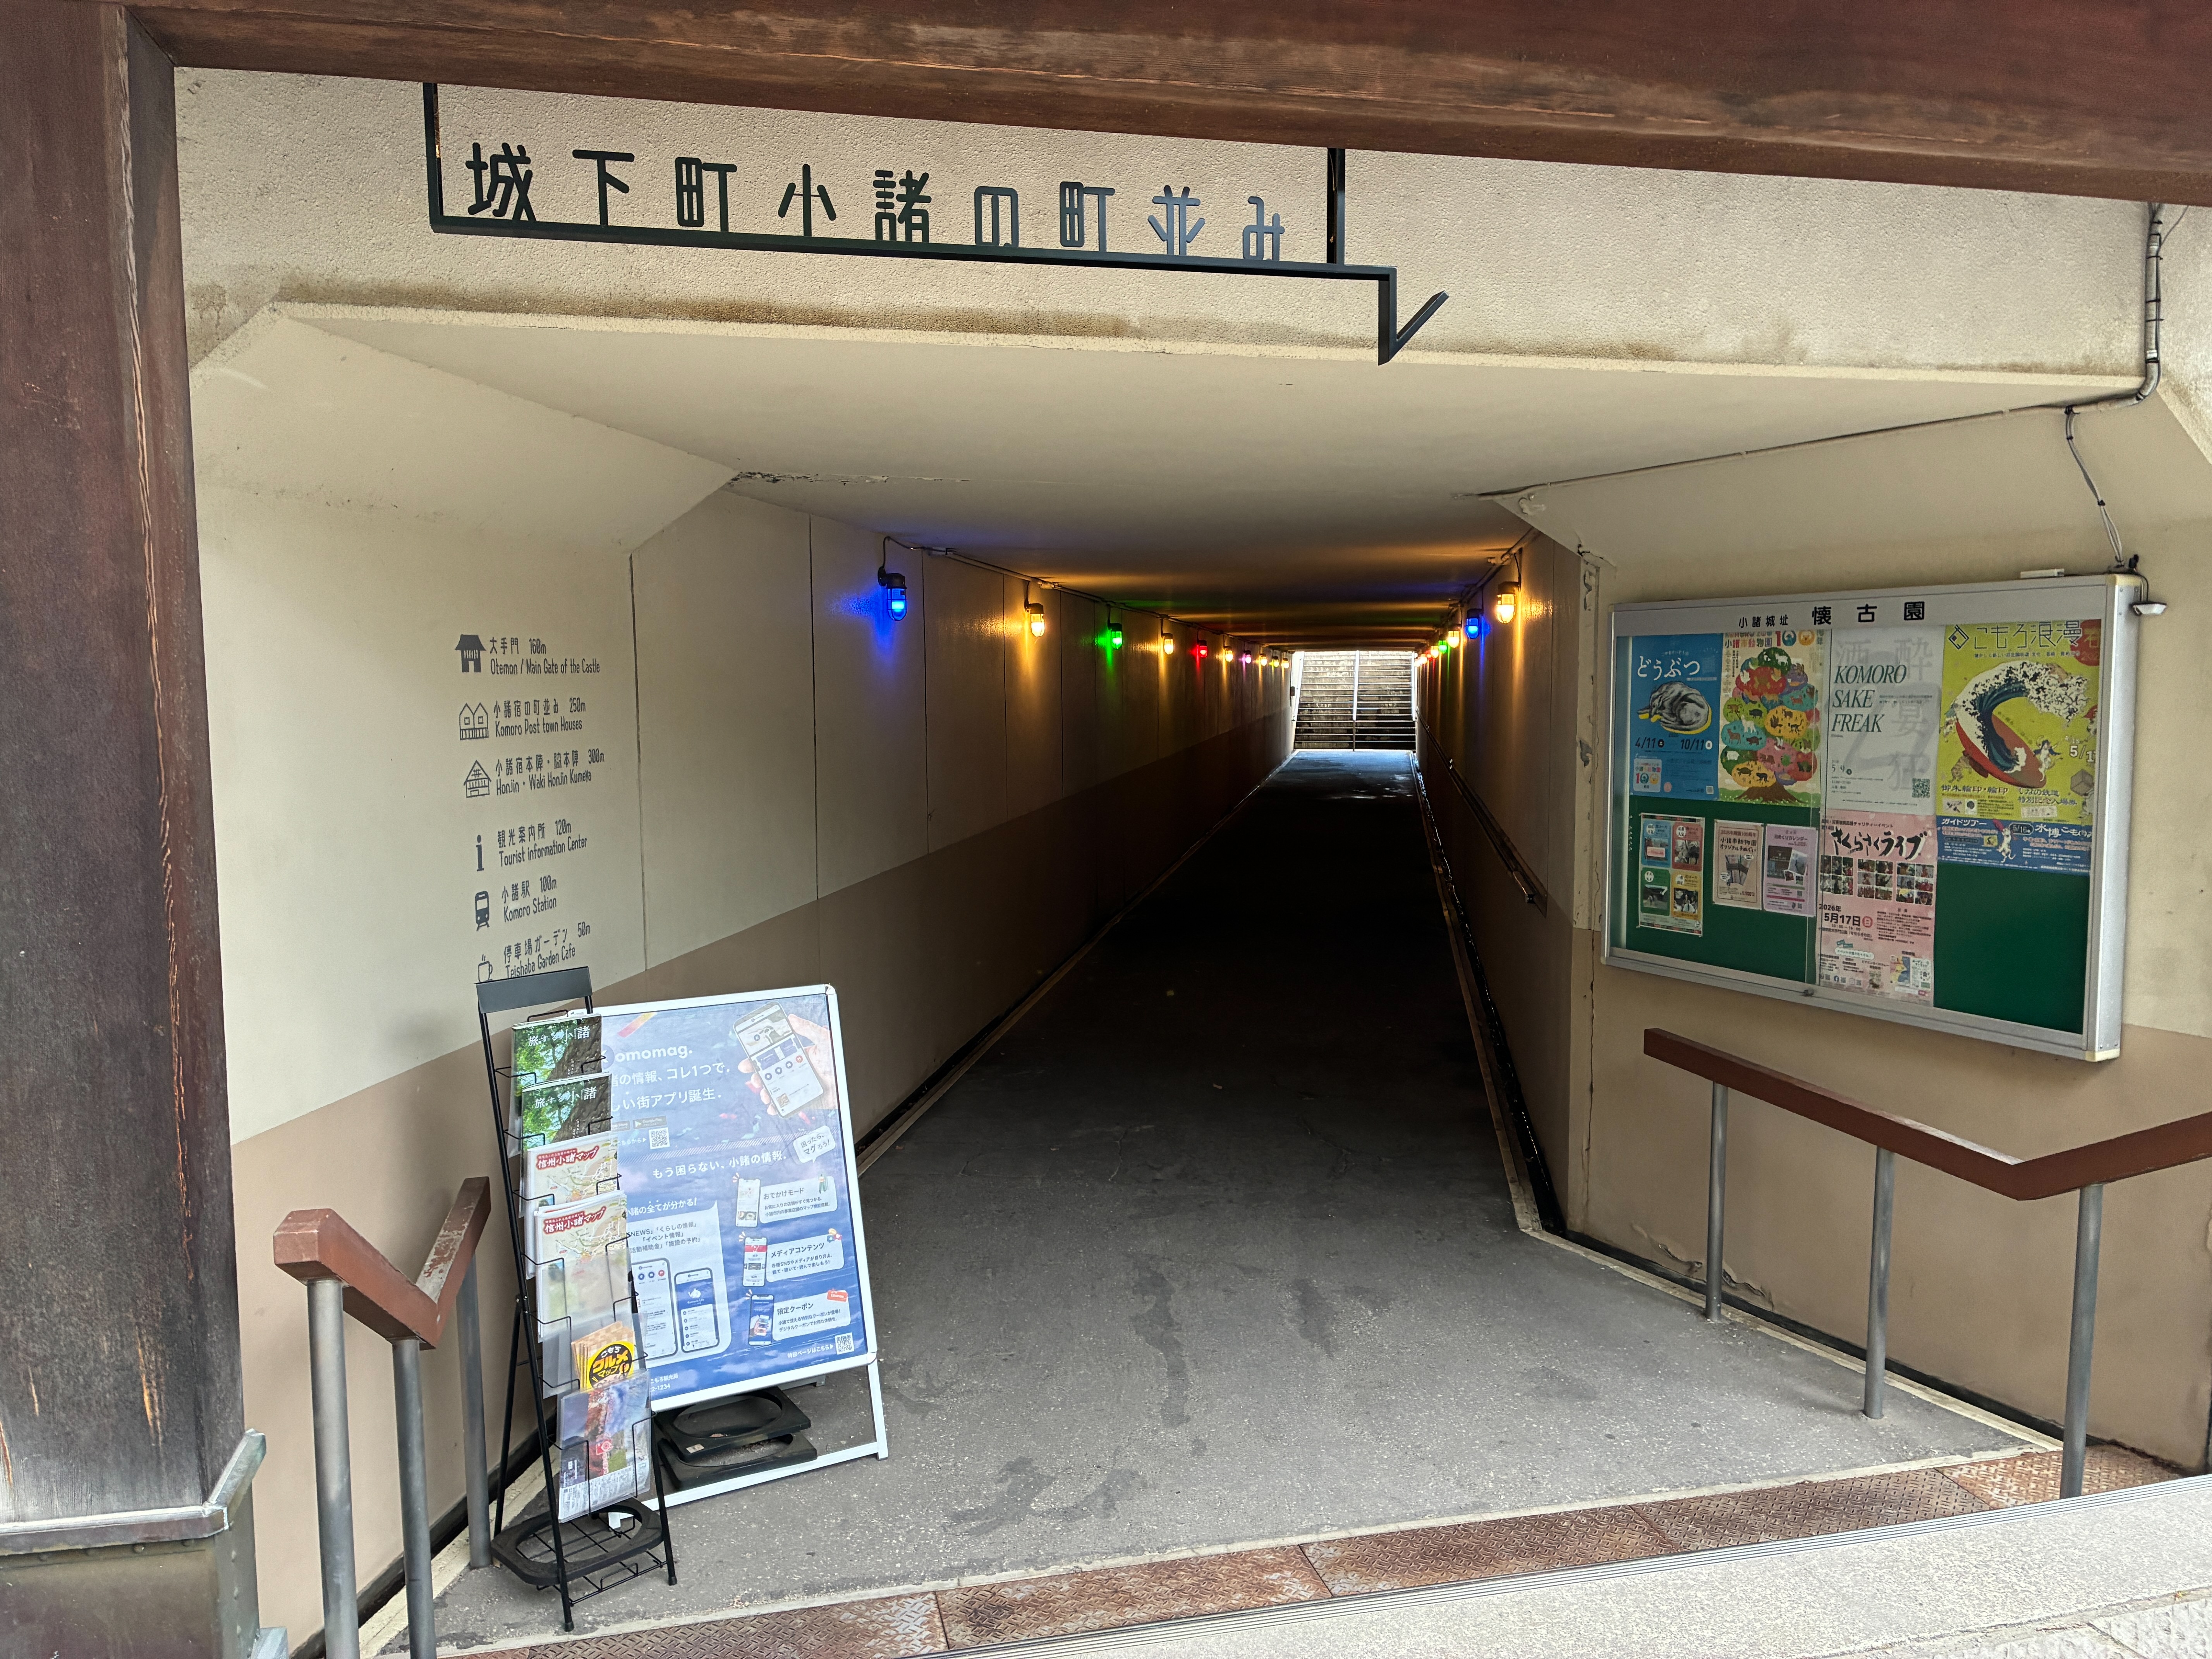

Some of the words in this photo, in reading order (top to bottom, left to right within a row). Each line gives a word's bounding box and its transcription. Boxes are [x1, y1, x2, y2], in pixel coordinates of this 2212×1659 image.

[464, 142, 1286, 262] 城下町小諸の町並み
[1738, 614, 1789, 628] 小諸城址
[1812, 601, 1925, 626] 懐古園
[1974, 620, 2083, 649] こもろ浪漫
[489, 637, 519, 655] 大手門
[529, 638, 547, 654] 160m
[490, 659, 518, 675] Otemon
[526, 658, 541, 675] Main
[543, 659, 558, 674] Gate
[560, 659, 568, 674] of
[570, 659, 580, 674] the
[582, 658, 600, 673] Castle
[1637, 655, 1700, 681] どうぶつ
[1833, 665, 1907, 684] KOMORO
[493, 698, 559, 719] 小諸宿の町並み
[569, 697, 586, 713] 250m
[1832, 689, 1875, 708] SAKE
[495, 721, 522, 737] Komoro
[524, 718, 540, 735] Post
[542, 717, 558, 733] town
[560, 716, 582, 732] Houses
[1831, 714, 1885, 732] FREAK
[1635, 737, 1656, 749] 4/11
[1680, 738, 1704, 750] 10/11
[2069, 744, 2096, 763] 5/1
[495, 750, 579, 777] 小諸宿本陣・脇本陣
[587, 748, 605, 764] 300m
[496, 779, 519, 796] Honjin
[529, 773, 545, 790] Waki
[569, 768, 592, 785] Kumeya
[1941, 818, 1987, 826] ガイドツアー
[497, 823, 545, 848] 観光案内所
[555, 818, 572, 836] 120m
[1831, 826, 1927, 860] さくらさくライブ
[499, 846, 525, 867] Tourist
[527, 838, 565, 861] information
[567, 836, 588, 851] Center
[501, 880, 530, 904] 小諸駅
[539, 875, 557, 893] 100m
[503, 905, 530, 923] Komoro
[532, 895, 557, 914] Station
[1819, 903, 1841, 912] 2026年
[1824, 912, 1861, 927] 5月17日
[503, 928, 568, 964] 停車場ガーデン
[577, 921, 591, 938] 50m
[505, 959, 536, 979] Teishaba
[537, 951, 559, 969] Garden
[561, 945, 575, 961] Cafe
[537, 1147, 599, 1169] 信州小諸マップ
[763, 1187, 804, 1200] おでかけモード
[544, 1207, 606, 1233] 信州小諸マップ
[771, 1242, 824, 1258] メディアコンテンツ
[777, 1302, 814, 1316] 限定クーポン
[600, 1346, 622, 1358] こもろ
[597, 1364, 620, 1378] マップ
